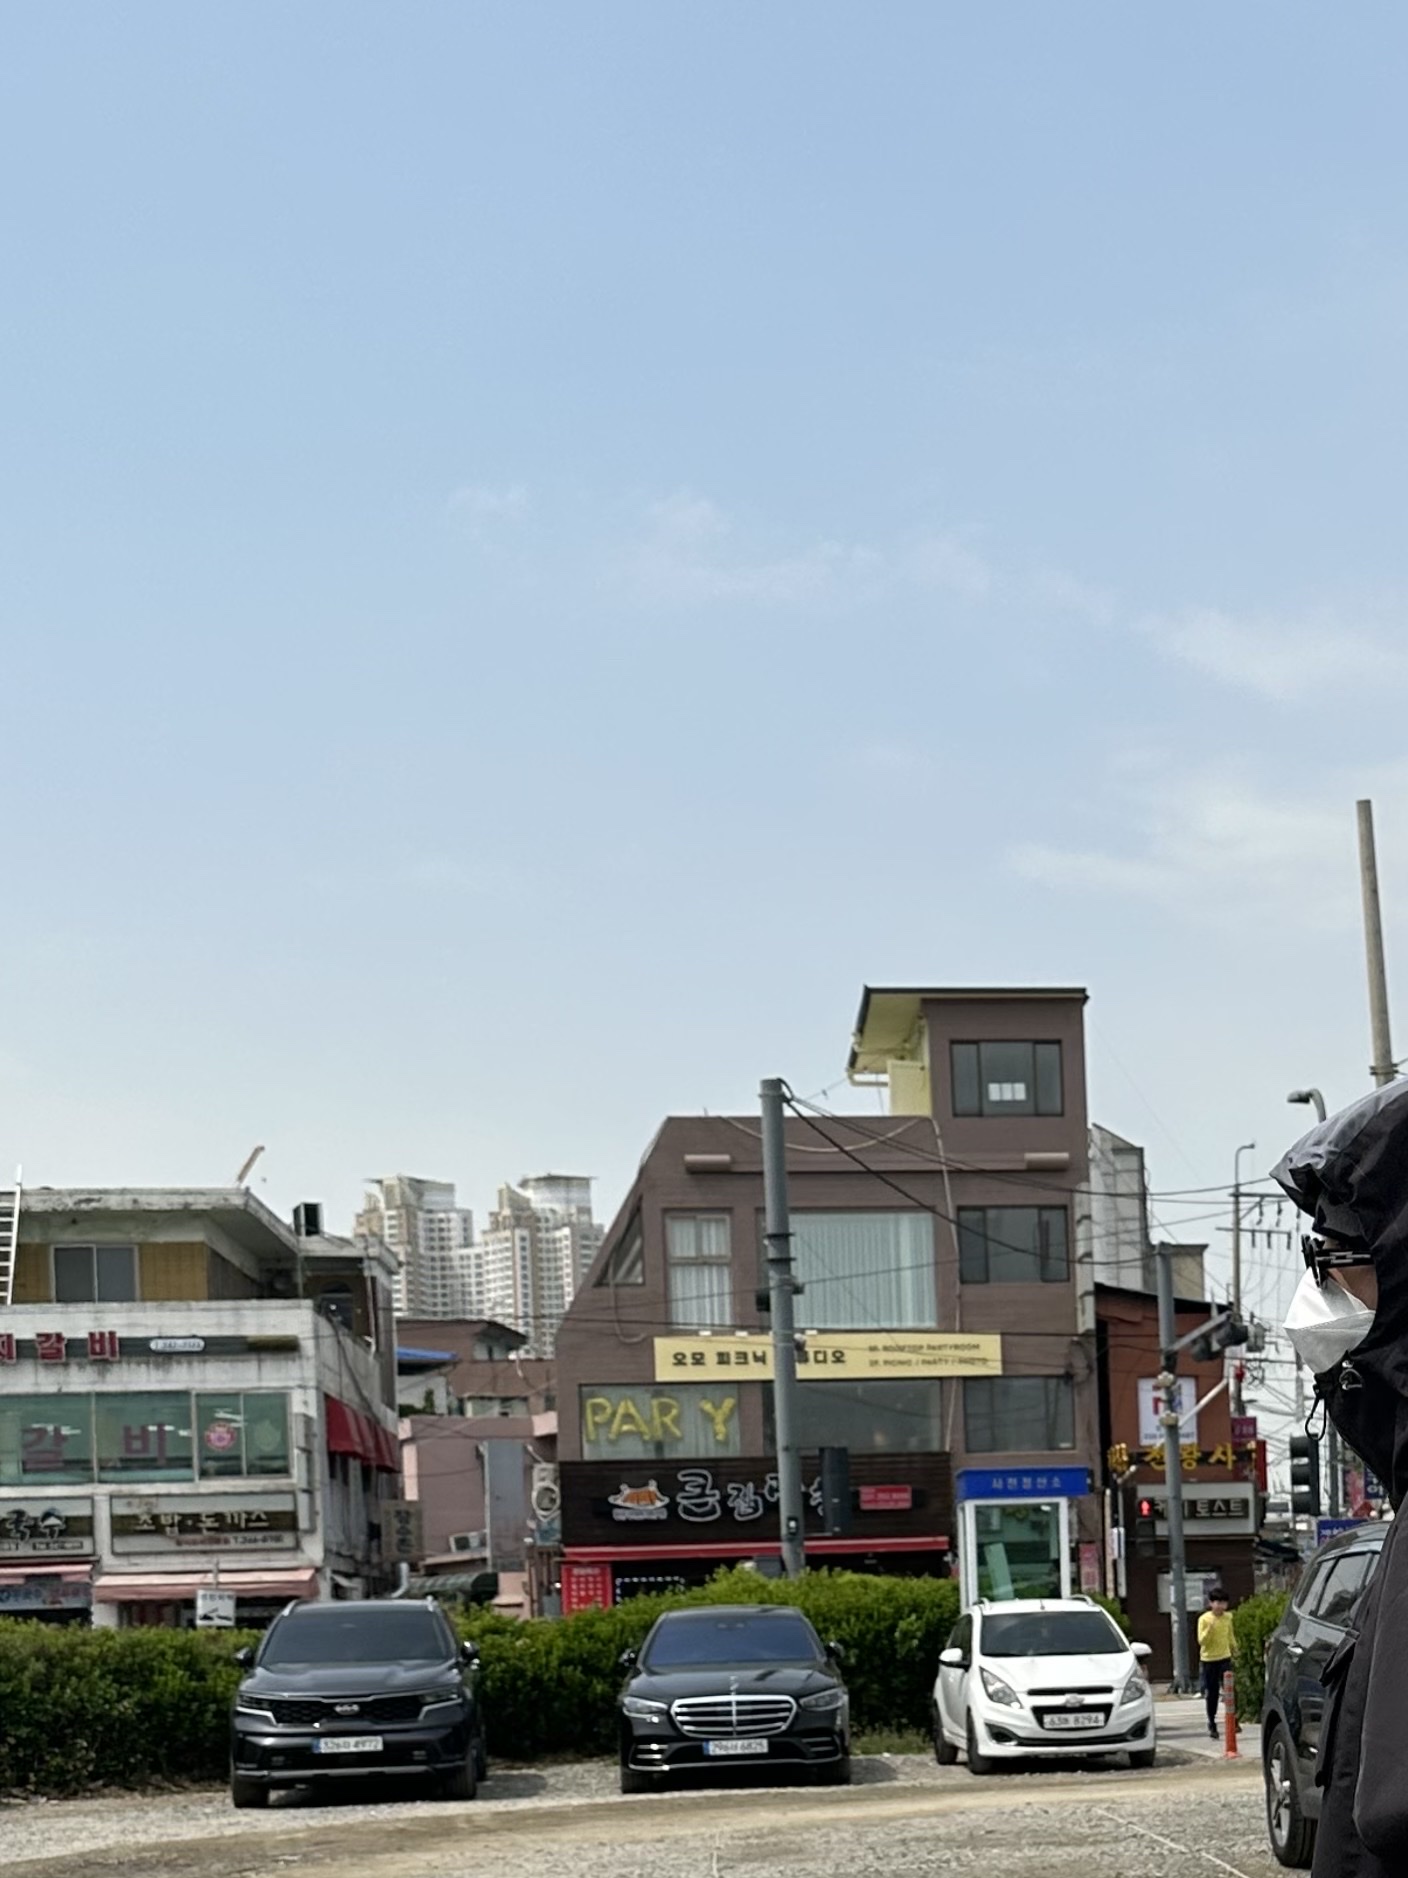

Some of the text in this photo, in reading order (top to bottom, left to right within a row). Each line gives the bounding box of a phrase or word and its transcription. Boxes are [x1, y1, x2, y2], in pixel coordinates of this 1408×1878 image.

[672, 1352, 706, 1366] 오모
[716, 1351, 767, 1365] 피크닉
[1195, 1500, 1245, 1517] 토스트
